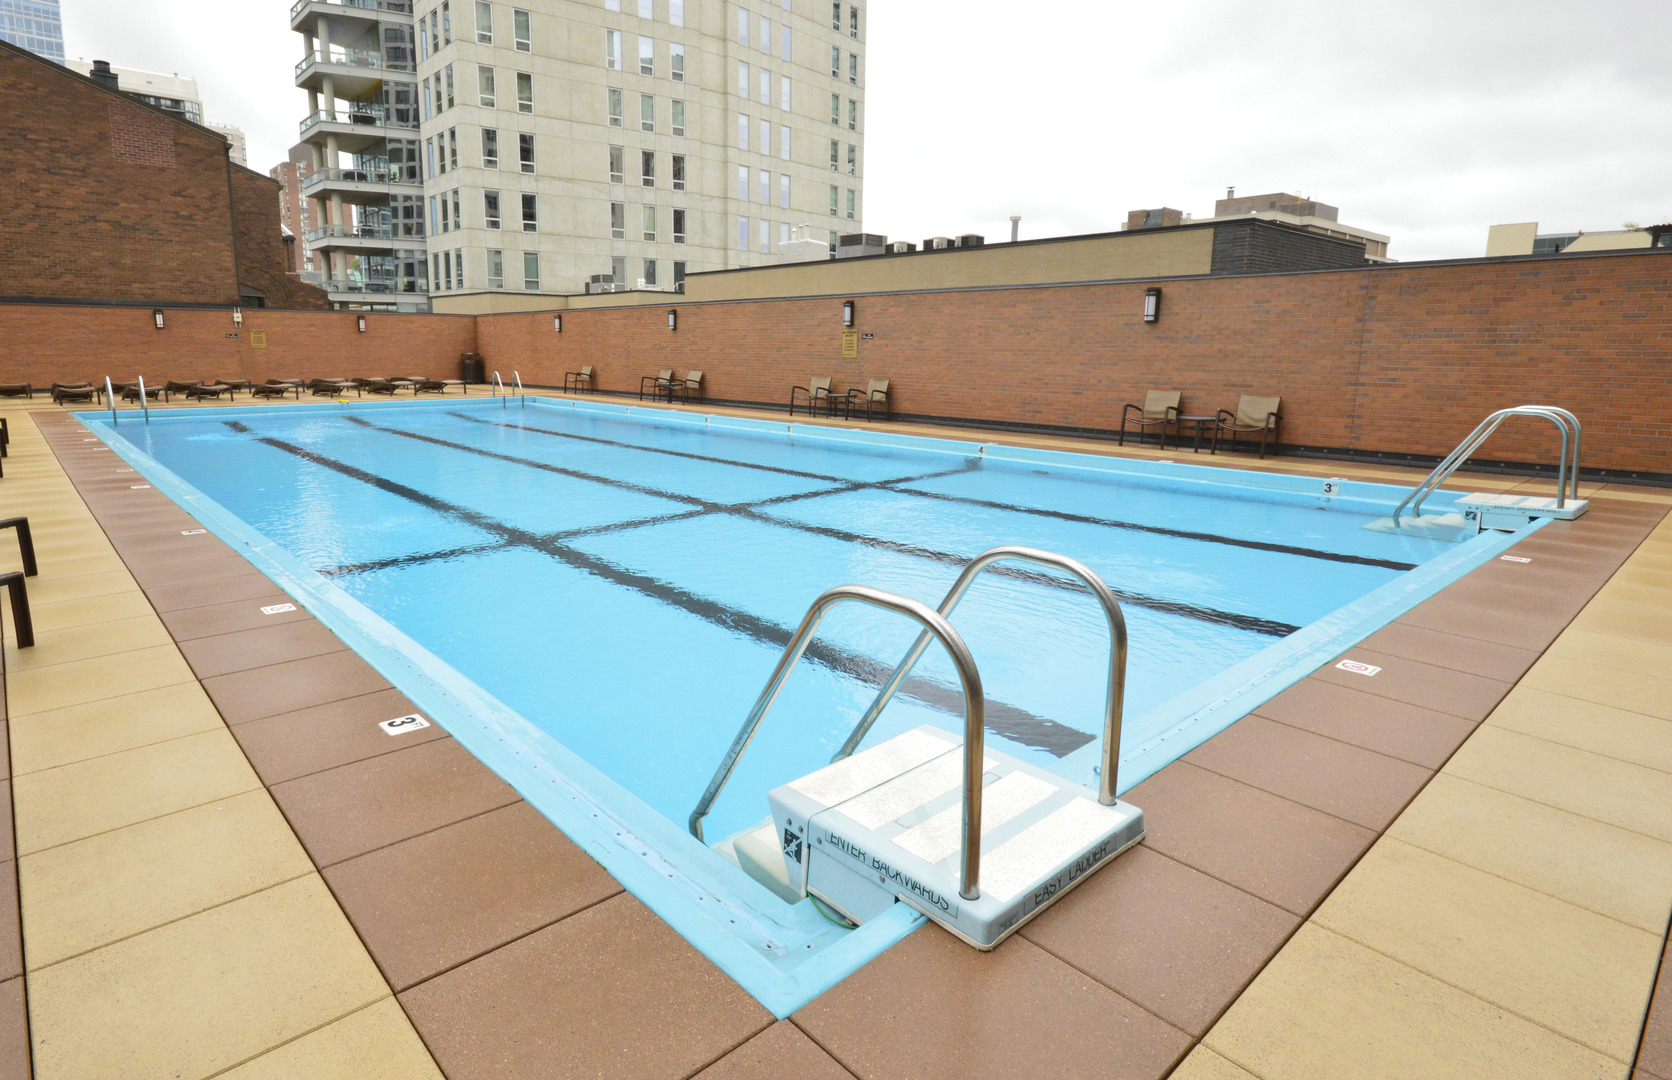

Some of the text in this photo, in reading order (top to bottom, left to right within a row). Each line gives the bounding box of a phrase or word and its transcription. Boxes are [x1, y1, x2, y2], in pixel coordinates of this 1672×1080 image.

[786, 425, 792, 433] 5
[978, 446, 983, 454] 4
[1324, 483, 1332, 493] 3
[387, 717, 417, 728] 3
[1034, 843, 1108, 906] EASY LADDER
[872, 856, 950, 911] BACKWARDS
